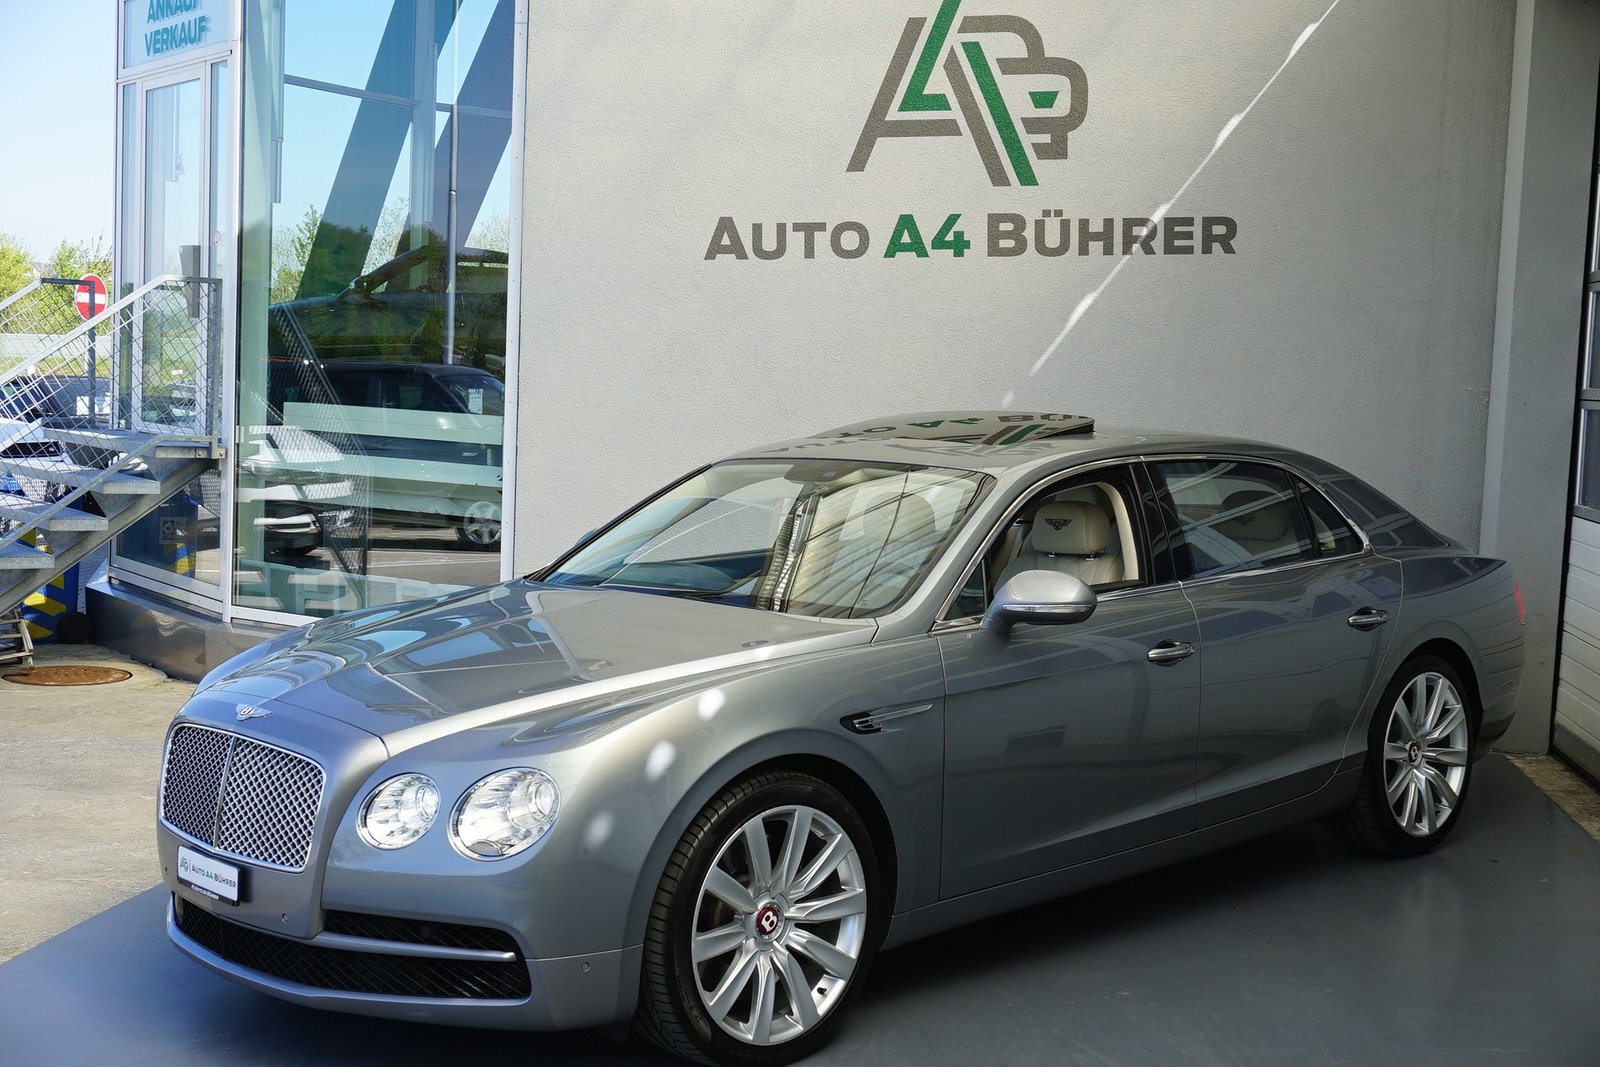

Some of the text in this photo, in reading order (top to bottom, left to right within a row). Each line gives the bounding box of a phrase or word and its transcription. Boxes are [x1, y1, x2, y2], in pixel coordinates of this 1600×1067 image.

[144, 15, 207, 56] VERKAUF
[704, 209, 1237, 260] AUTO A4 BÜHRER
[192, 865, 205, 877] AUTO
[761, 910, 778, 932] B
